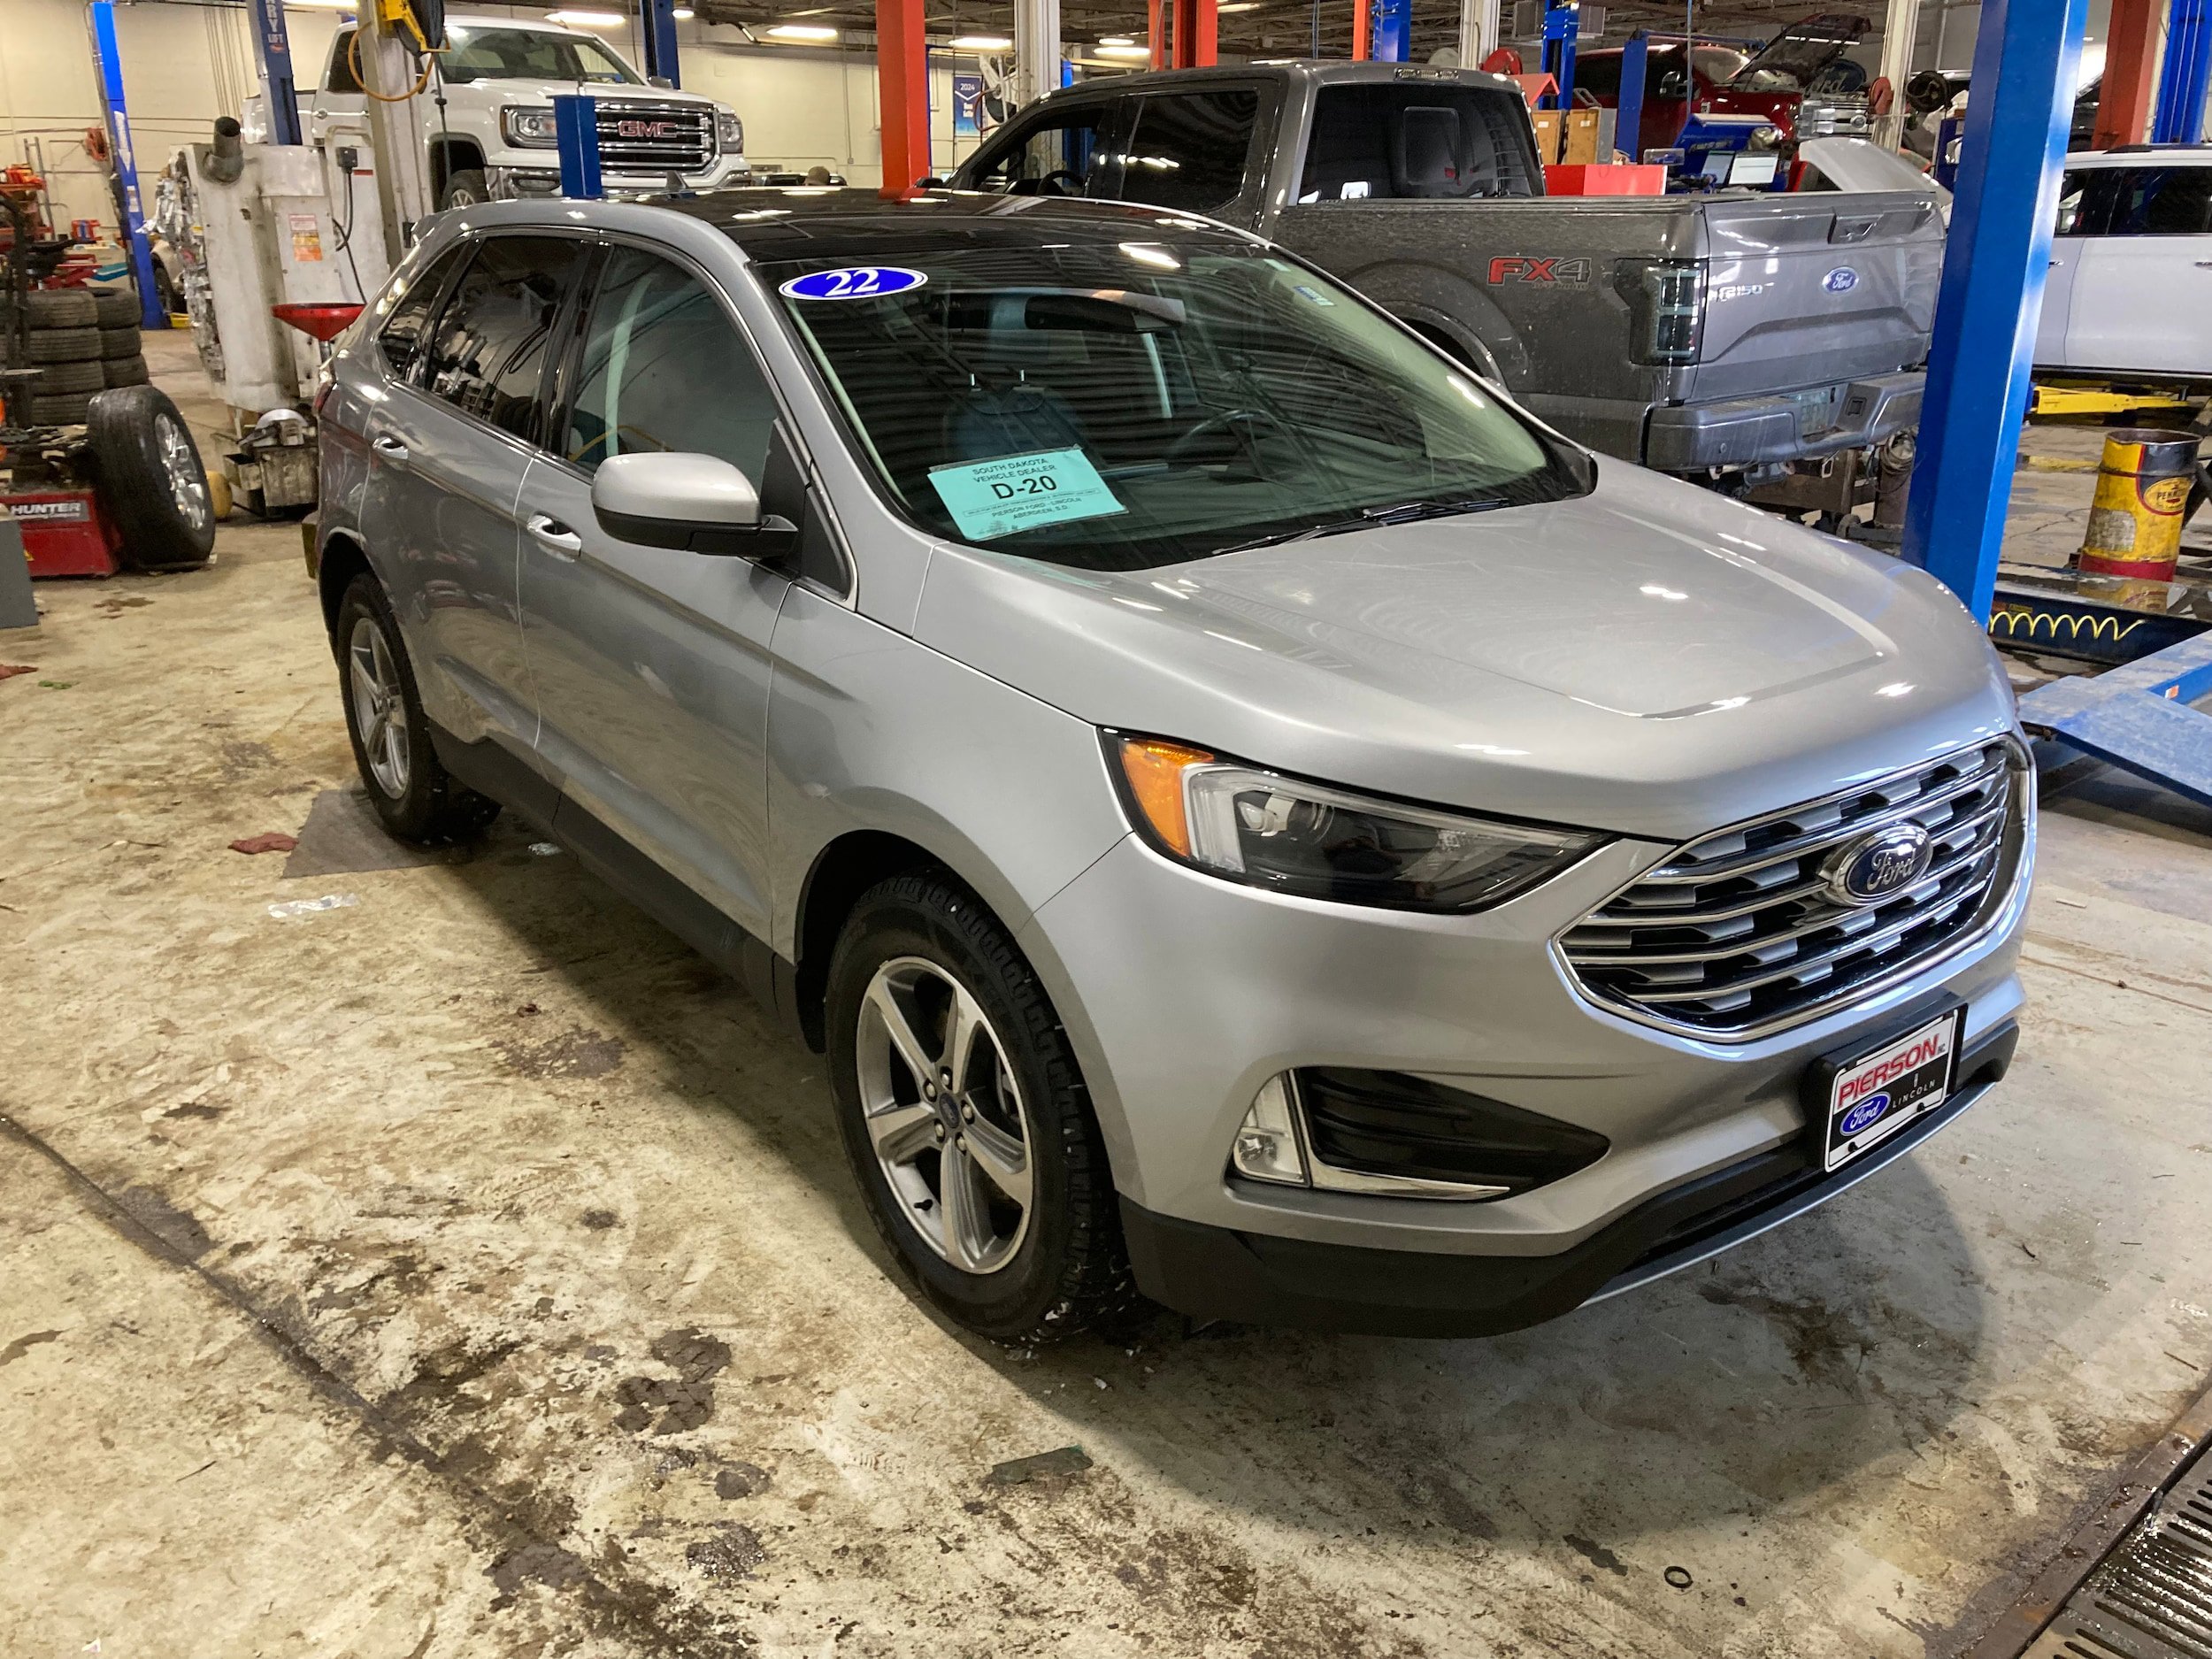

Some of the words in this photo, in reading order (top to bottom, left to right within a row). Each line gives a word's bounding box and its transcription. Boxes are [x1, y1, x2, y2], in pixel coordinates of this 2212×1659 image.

[618, 120, 678, 138] GMC
[824, 269, 880, 296] 22
[1487, 256, 1592, 286] FX4
[1832, 273, 1854, 289] Ford
[972, 465, 1006, 475] SOUTH
[1008, 458, 1049, 469] DAKOTA
[973, 472, 1016, 483] VEHICLE
[1017, 465, 1057, 477] DEALER
[991, 475, 1057, 499] D-20
[11, 503, 81, 514] HUNTER
[992, 506, 1025, 518] PIERSON
[1025, 502, 1046, 511] FORD
[1867, 843, 1916, 891] Ford
[1838, 1033, 1939, 1109] PIERSON
[1893, 1079, 1936, 1109] LINCOLN
[1849, 1100, 1881, 1129] Ford
